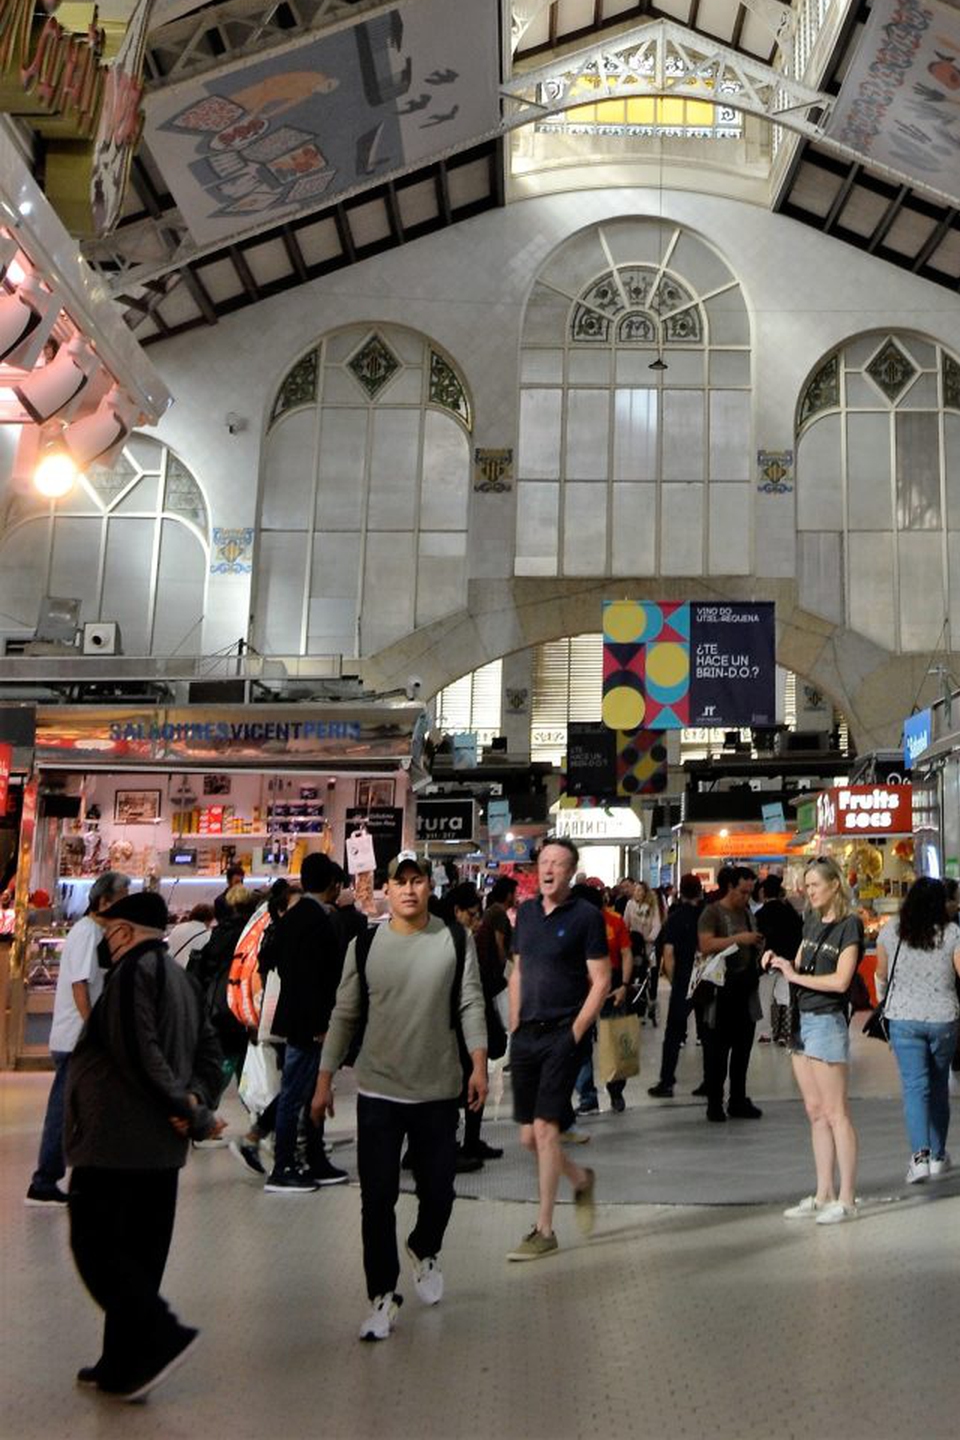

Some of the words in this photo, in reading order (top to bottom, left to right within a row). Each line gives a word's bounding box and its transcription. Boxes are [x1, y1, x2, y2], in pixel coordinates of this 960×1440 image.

[696, 644, 718, 655] ¿TE
[696, 655, 729, 666] HACE
[731, 655, 749, 666] UN
[230, 721, 302, 741] VICENT
[839, 789, 899, 810] Fruits
